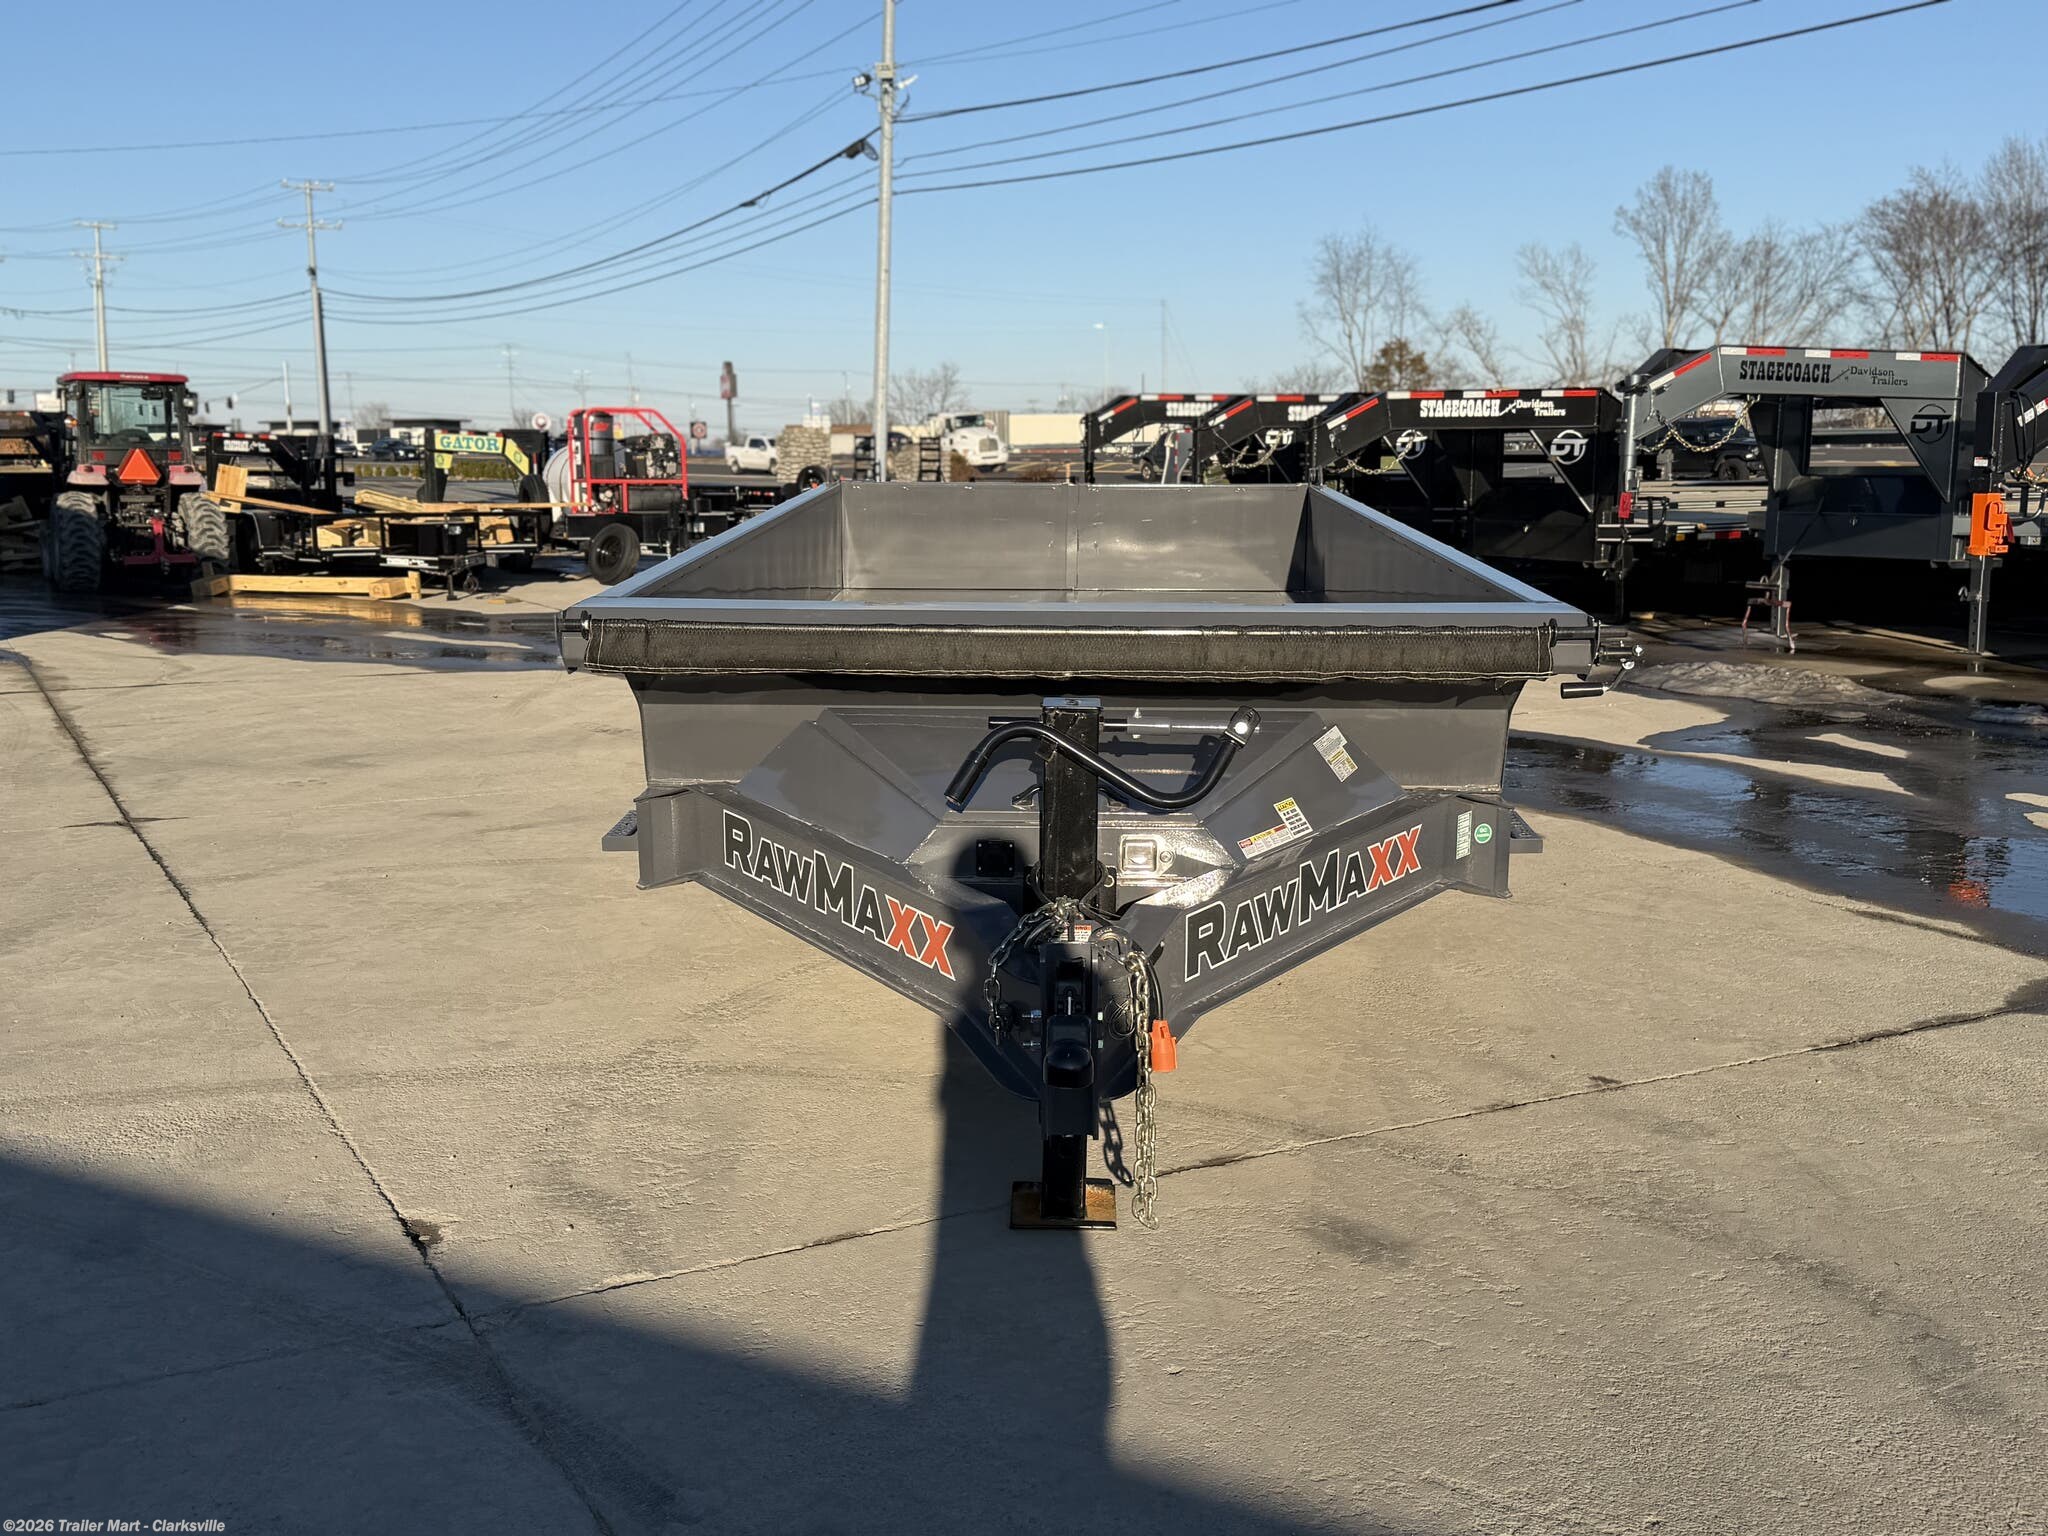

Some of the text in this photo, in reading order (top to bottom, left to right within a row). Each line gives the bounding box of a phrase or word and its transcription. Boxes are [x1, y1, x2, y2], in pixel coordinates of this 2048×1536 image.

[1739, 360, 1894, 383] STAGECOACH Davidson
[1871, 376, 1908, 387] Trailers
[1420, 399, 1554, 417] STAGECOACH Davidson
[1534, 408, 1566, 416] Trailers
[1911, 414, 1953, 434] DT
[440, 436, 499, 451] GATOR
[1550, 438, 1589, 456] DT
[723, 809, 956, 981] RAWMAXX
[1184, 824, 1422, 982] RAWMAXX
